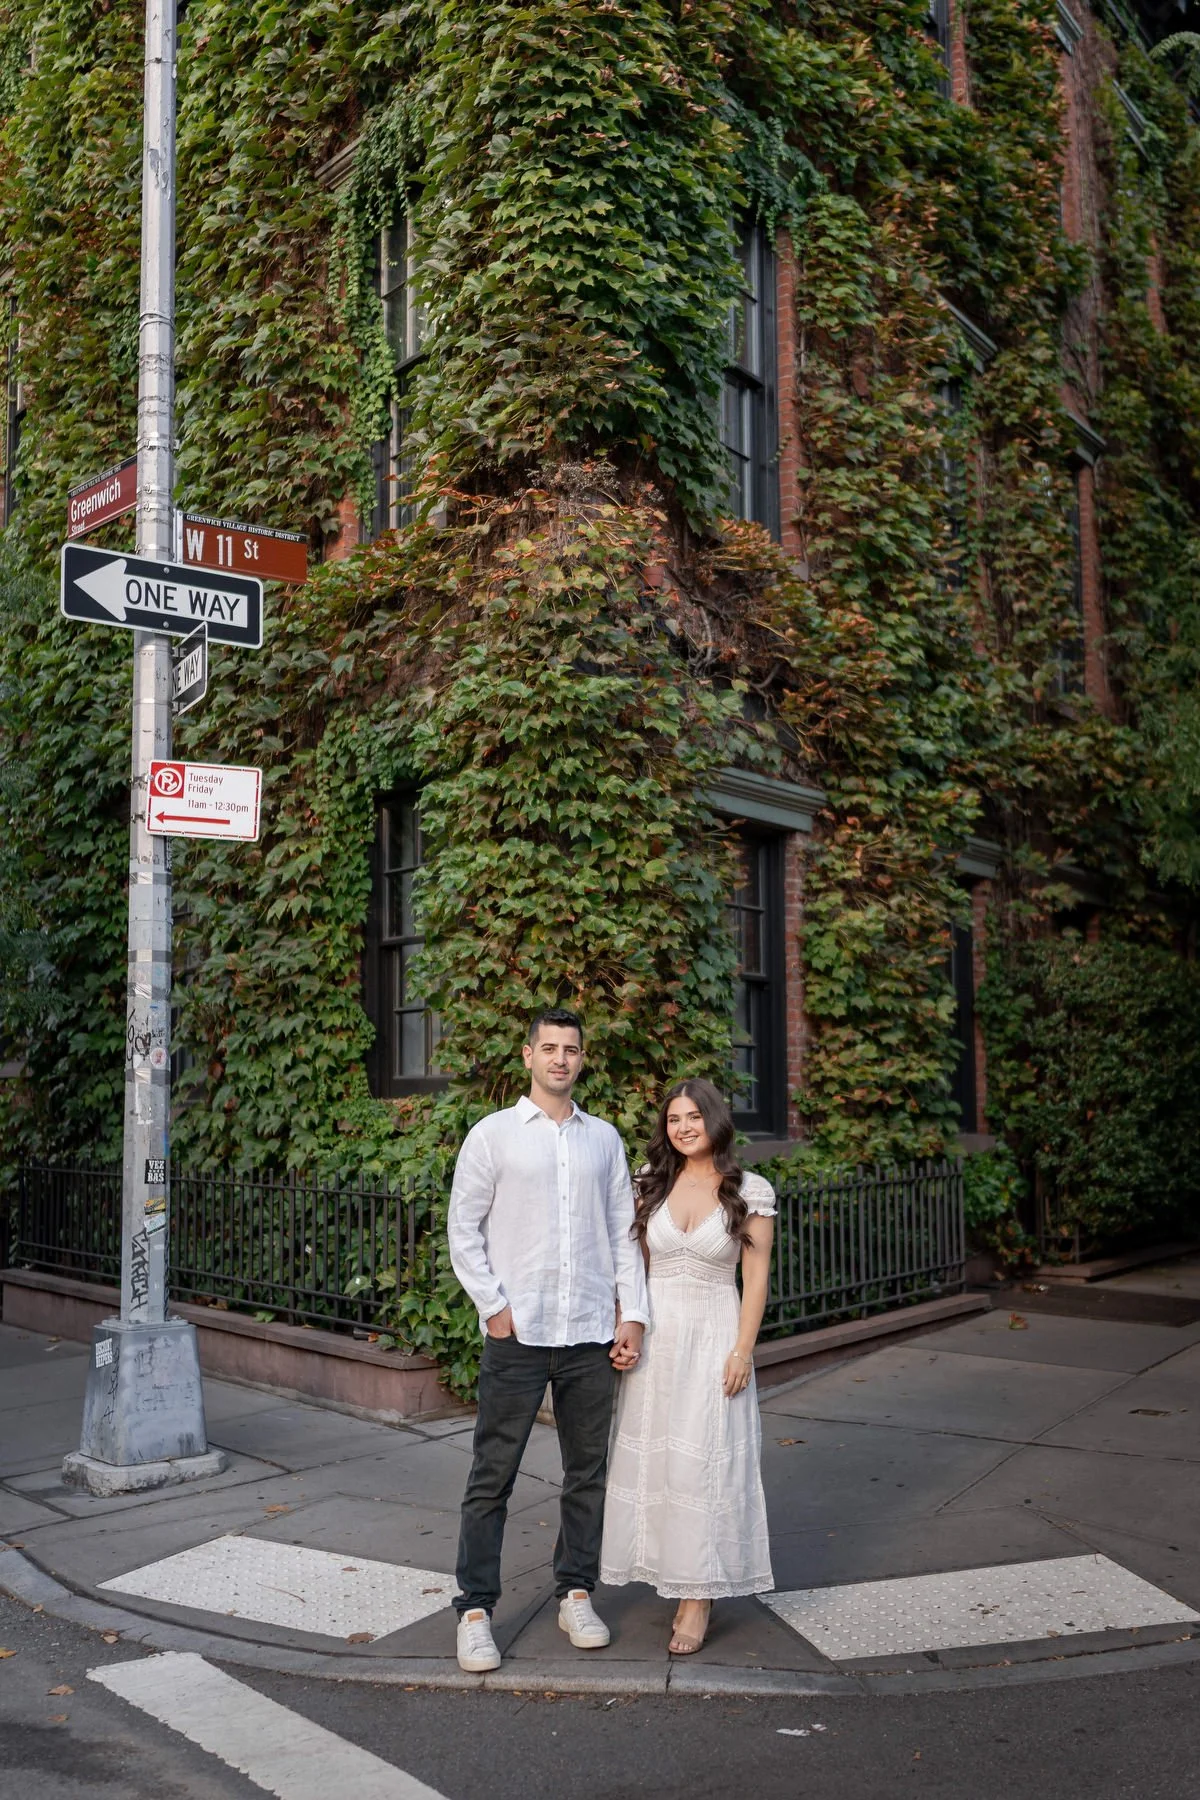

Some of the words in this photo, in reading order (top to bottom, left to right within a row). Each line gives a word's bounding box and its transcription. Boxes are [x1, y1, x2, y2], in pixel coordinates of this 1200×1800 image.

[71, 477, 121, 522] Greenwich
[186, 514, 222, 527] GREENWICH
[222, 521, 247, 532] VILLAGE
[248, 526, 274, 537] HISTORIC
[275, 532, 300, 542] DISTRICT
[186, 528, 205, 561] W
[216, 534, 233, 567] 11
[244, 538, 259, 560] St
[125, 578, 178, 612] ONE
[188, 590, 240, 622] WAY
[172, 666, 182, 695] NE
[183, 649, 201, 687] WAY
[188, 784, 214, 796] Friday
[189, 773, 224, 785] Tuesday
[188, 799, 207, 809] 11am
[215, 801, 249, 813] 12:30pm
